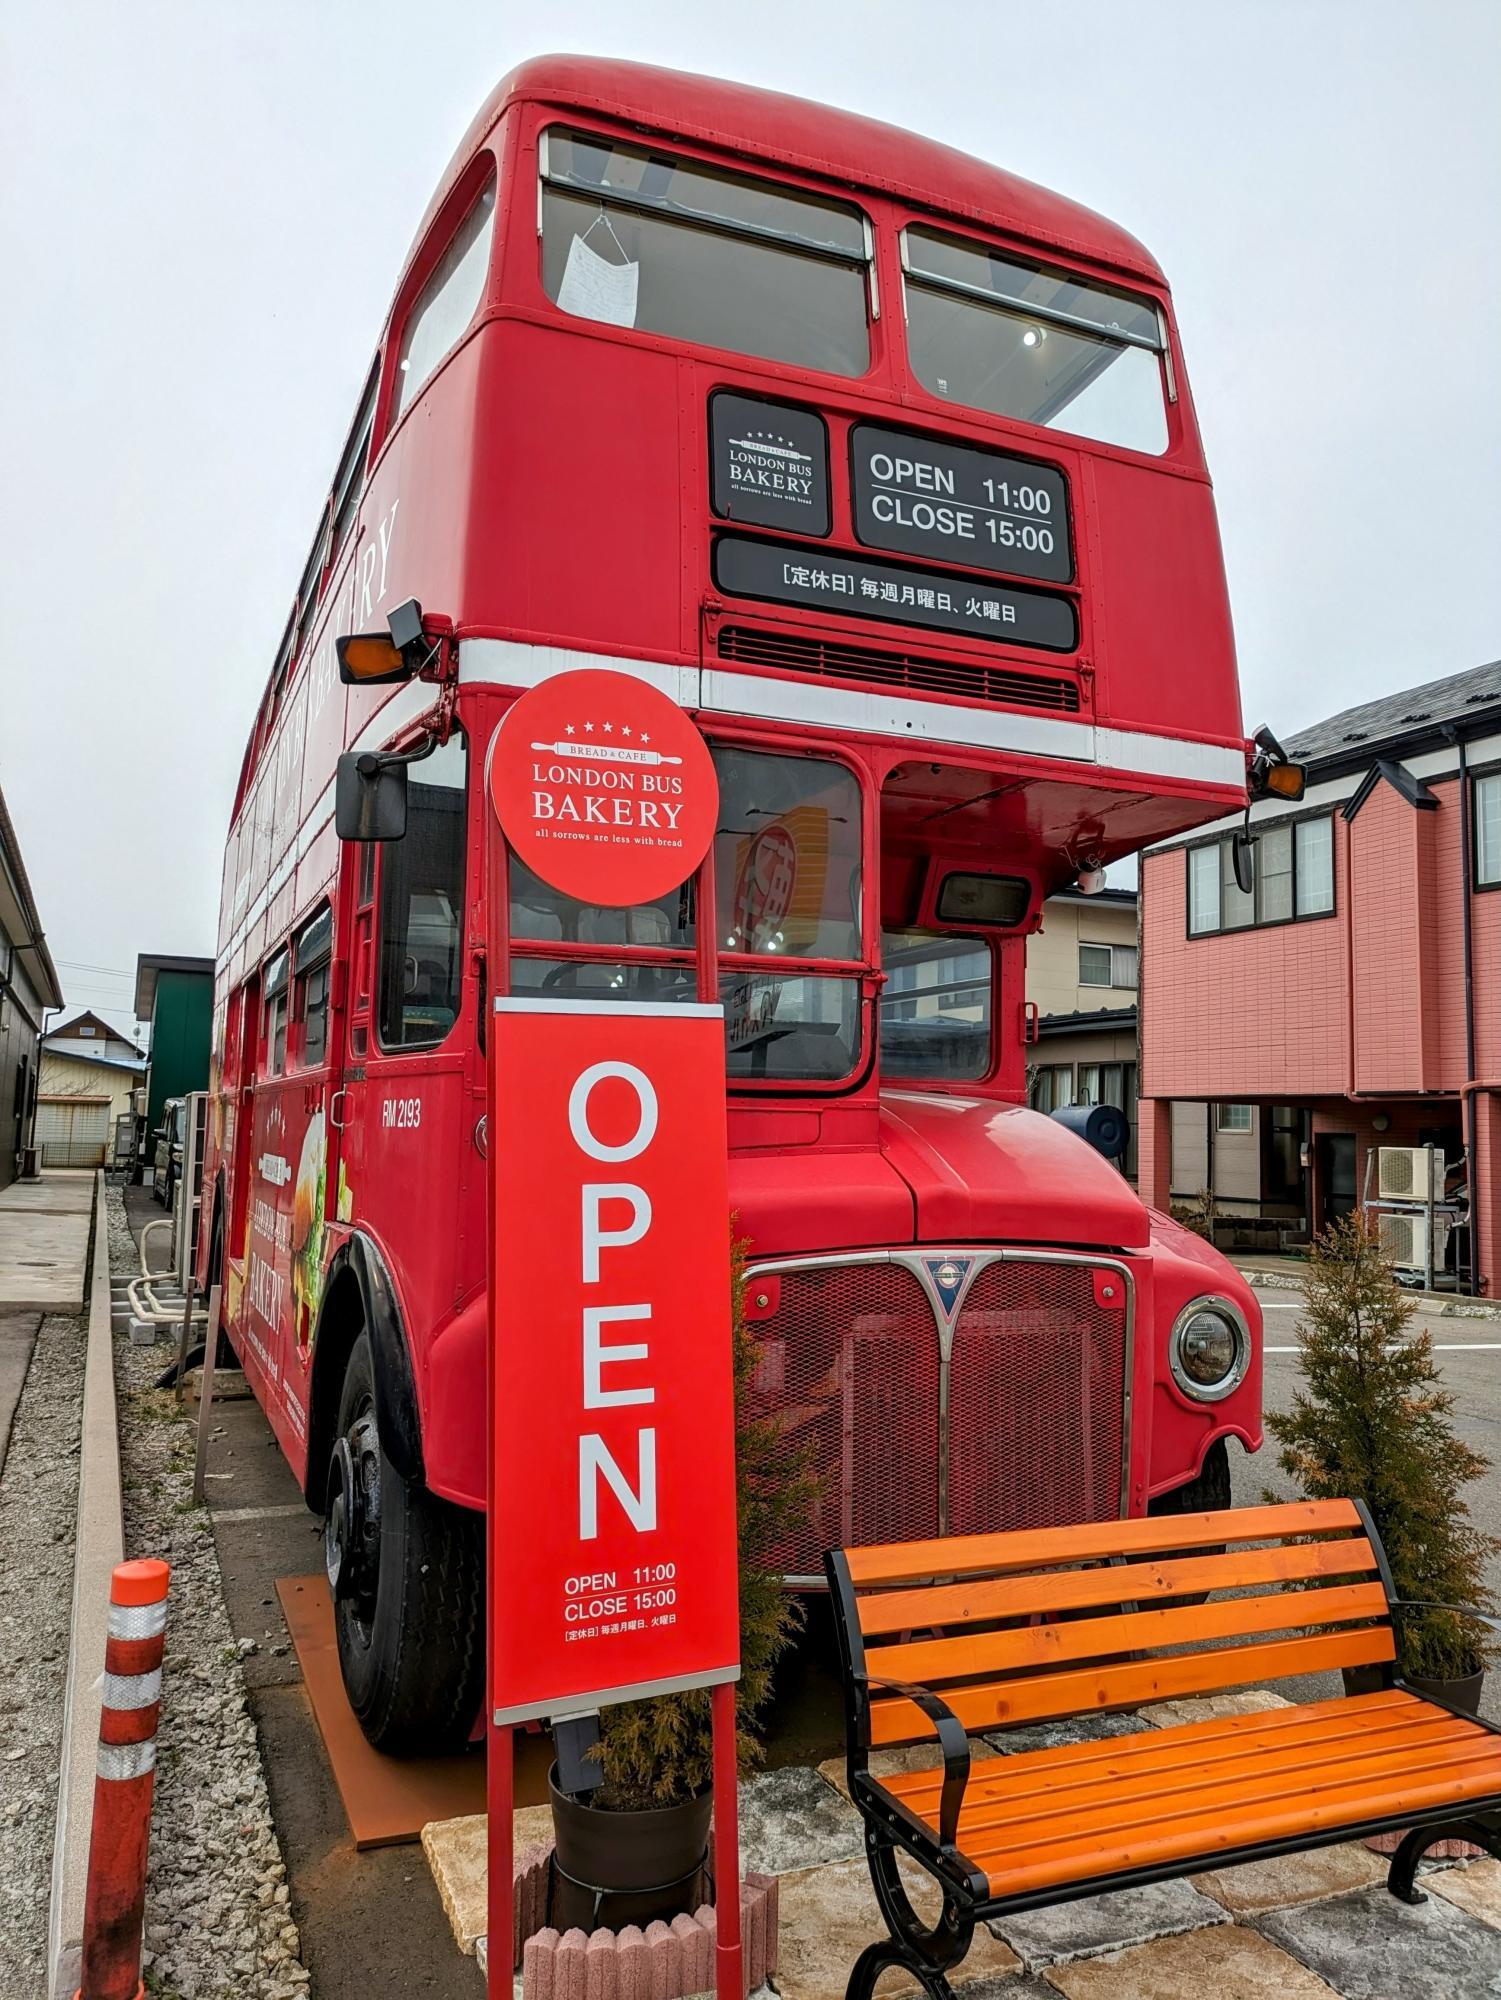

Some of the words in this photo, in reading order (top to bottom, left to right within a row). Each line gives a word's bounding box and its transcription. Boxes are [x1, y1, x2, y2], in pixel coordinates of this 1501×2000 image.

[729, 464, 813, 495] BAKERY
[730, 450, 785, 471] LONDON
[789, 463, 812, 477] BUS
[870, 454, 955, 495] OPEN
[983, 479, 1051, 515] 11:00
[871, 494, 976, 539] CLOSE
[984, 518, 1054, 554] 15:00
[569, 744, 608, 757] BREAD
[617, 751, 647, 761] CAFE
[532, 764, 635, 790] LONDON
[642, 774, 683, 795] BUS
[532, 791, 684, 829] BAKERY
[535, 828, 549, 838] all
[552, 831, 590, 841] sorrows
[594, 834, 609, 842] are
[612, 834, 630, 844] less
[634, 836, 654, 846] with
[657, 837, 683, 848] bread
[382, 1099, 397, 1128] RM
[397, 1098, 421, 1128] 2193
[250, 1251, 284, 1335] BAKERY
[568, 1060, 659, 1540] OPEN
[564, 1572, 616, 1595] OPEN
[633, 1563, 676, 1584] 11:00
[564, 1597, 628, 1622] CLOSE
[633, 1589, 676, 1610] 15:00
